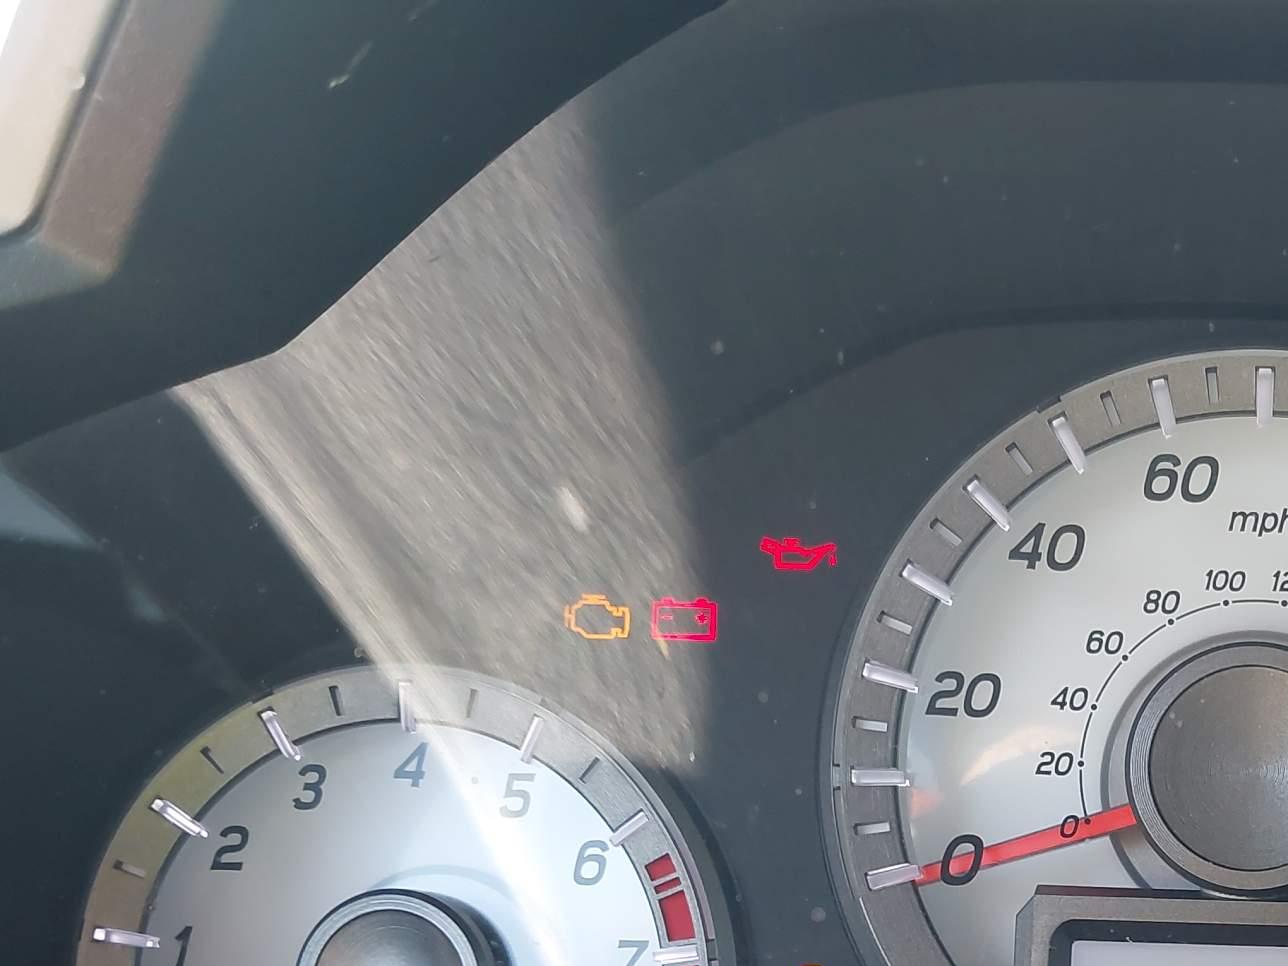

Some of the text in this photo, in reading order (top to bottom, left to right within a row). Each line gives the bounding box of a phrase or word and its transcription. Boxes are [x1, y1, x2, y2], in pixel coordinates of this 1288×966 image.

[1143, 453, 1220, 503] 60
[1008, 522, 1086, 572] 40
[1143, 589, 1181, 615] 80
[1205, 569, 1246, 592] 100
[1085, 630, 1124, 655] 60
[924, 670, 1002, 718] 20
[1050, 686, 1089, 711] 40
[393, 742, 427, 788] 4
[1035, 751, 1074, 776] 20
[292, 763, 327, 811] 3
[502, 772, 537, 818] 5
[210, 825, 250, 871] 2
[1060, 814, 1080, 838] 0
[573, 839, 610, 886] 6
[939, 833, 985, 887] 0
